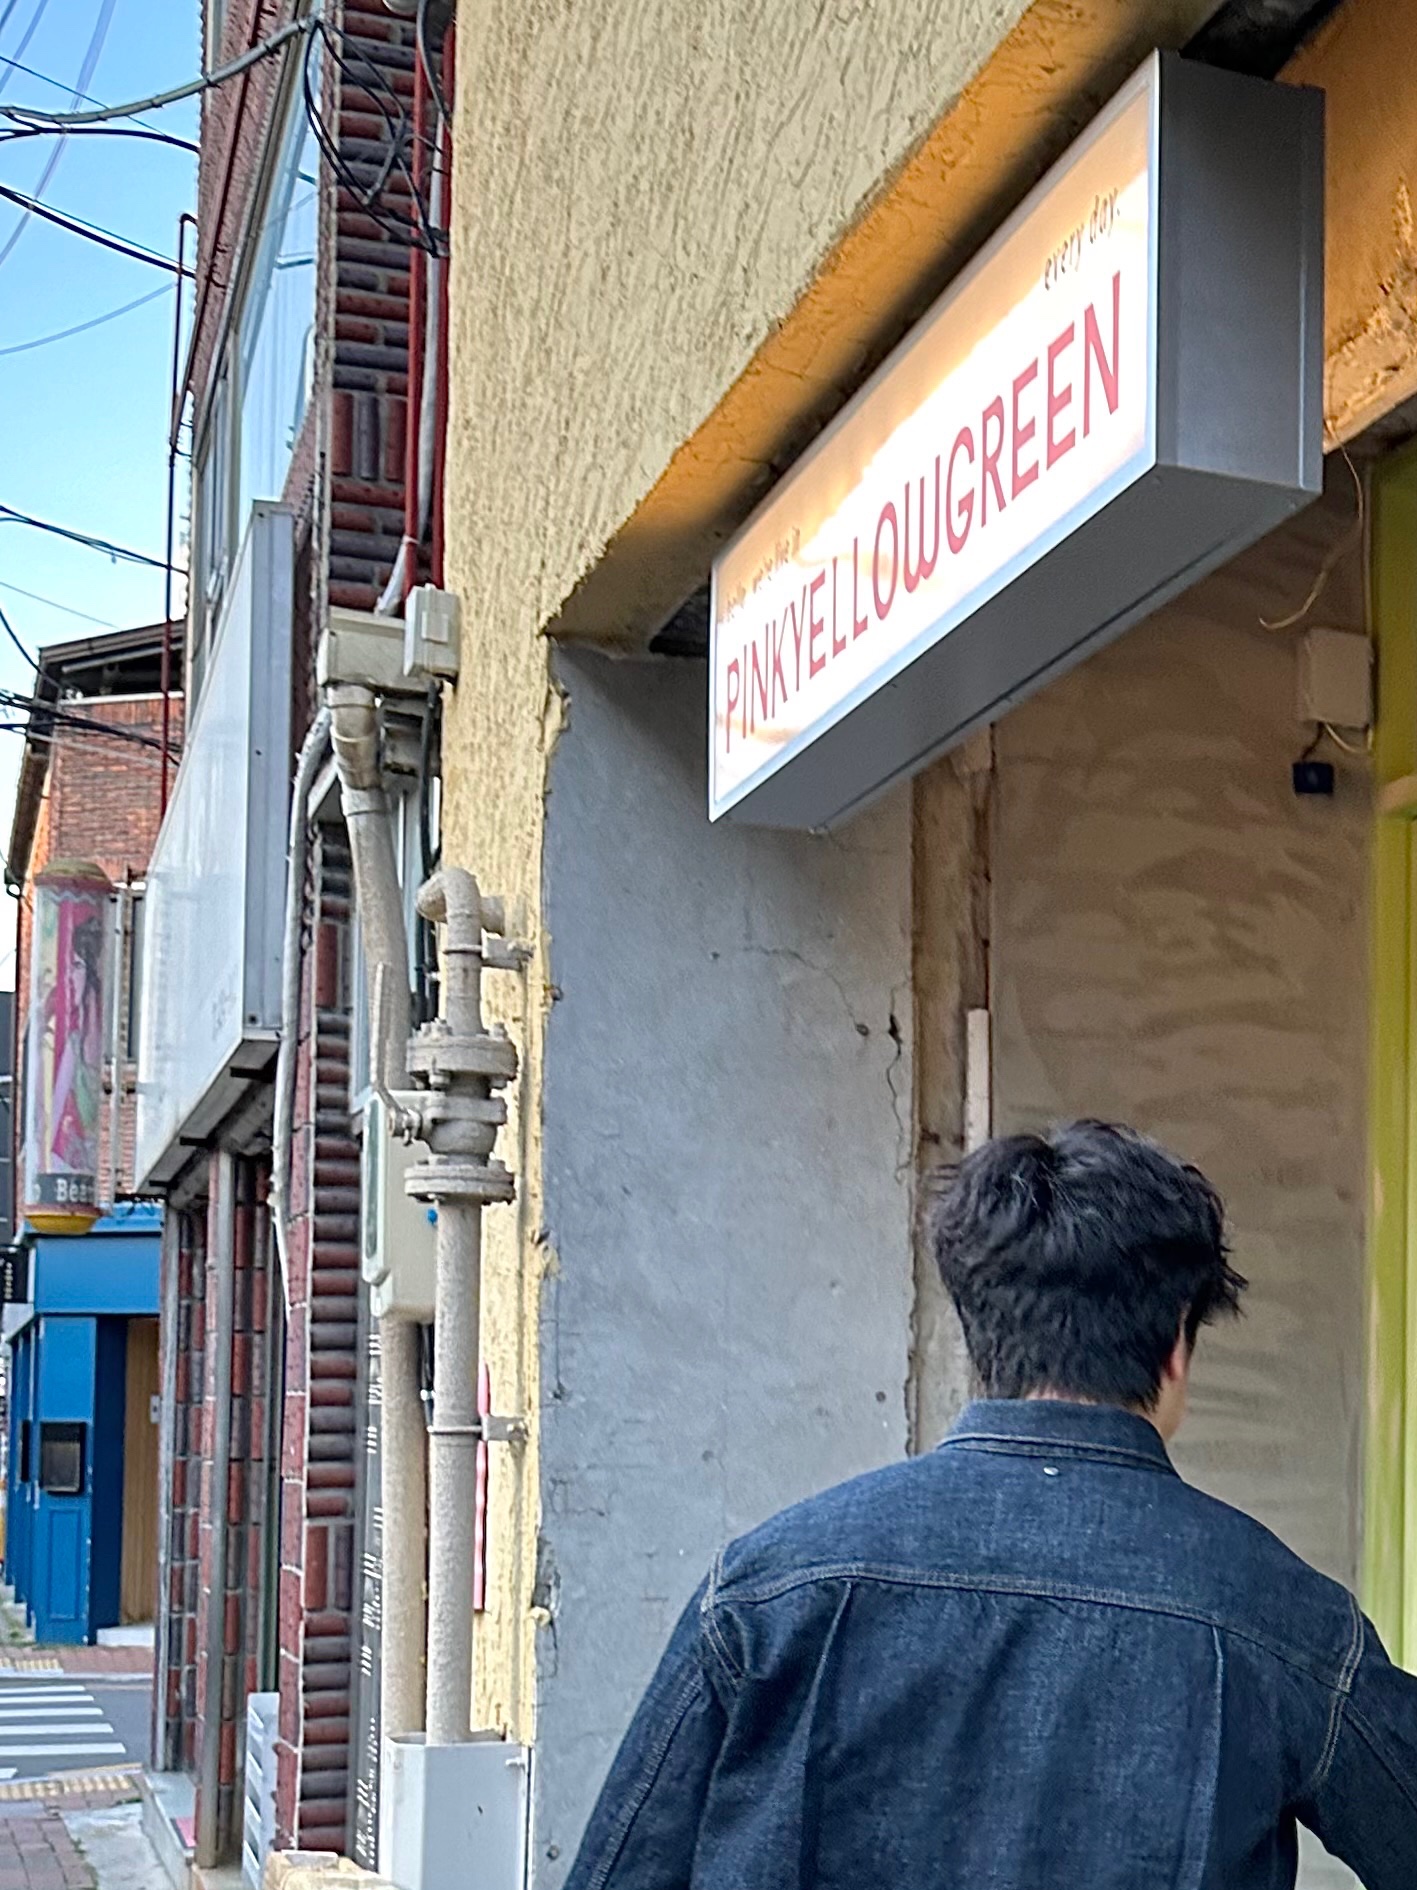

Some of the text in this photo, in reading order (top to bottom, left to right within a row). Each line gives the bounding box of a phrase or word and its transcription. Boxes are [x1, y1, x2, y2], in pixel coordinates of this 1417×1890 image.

[1044, 222, 1085, 291] every
[1089, 187, 1121, 245] day.
[726, 270, 1121, 754] PINKYELLOWGREEN
